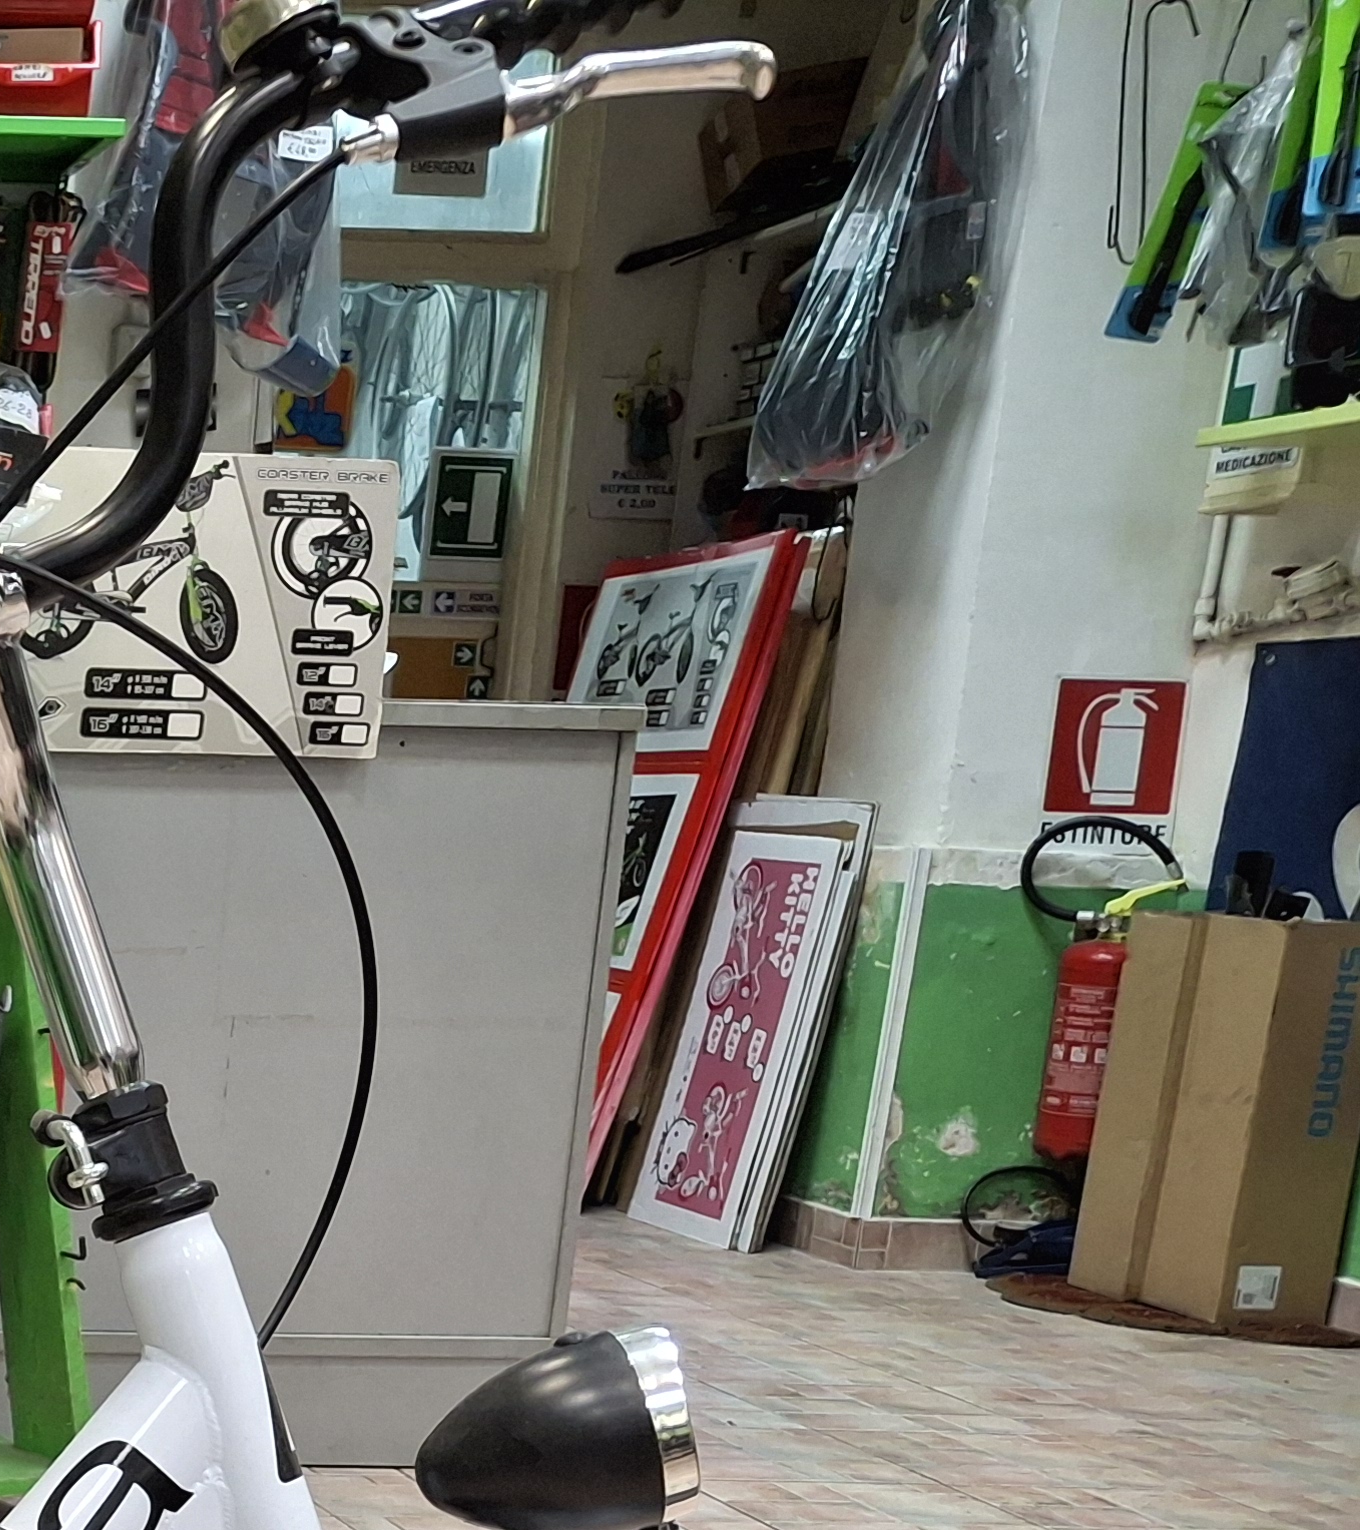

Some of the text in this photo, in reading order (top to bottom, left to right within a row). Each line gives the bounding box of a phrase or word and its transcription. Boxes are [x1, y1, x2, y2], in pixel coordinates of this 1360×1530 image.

[410, 160, 475, 174] EMERGENZA
[257, 469, 390, 483] COASTER BRAKE
[1215, 447, 1293, 474] MEDICAZIONE
[768, 873, 804, 970] KITTY
[780, 867, 819, 979] HELLO
[1306, 947, 1360, 1138] SHIMANO
